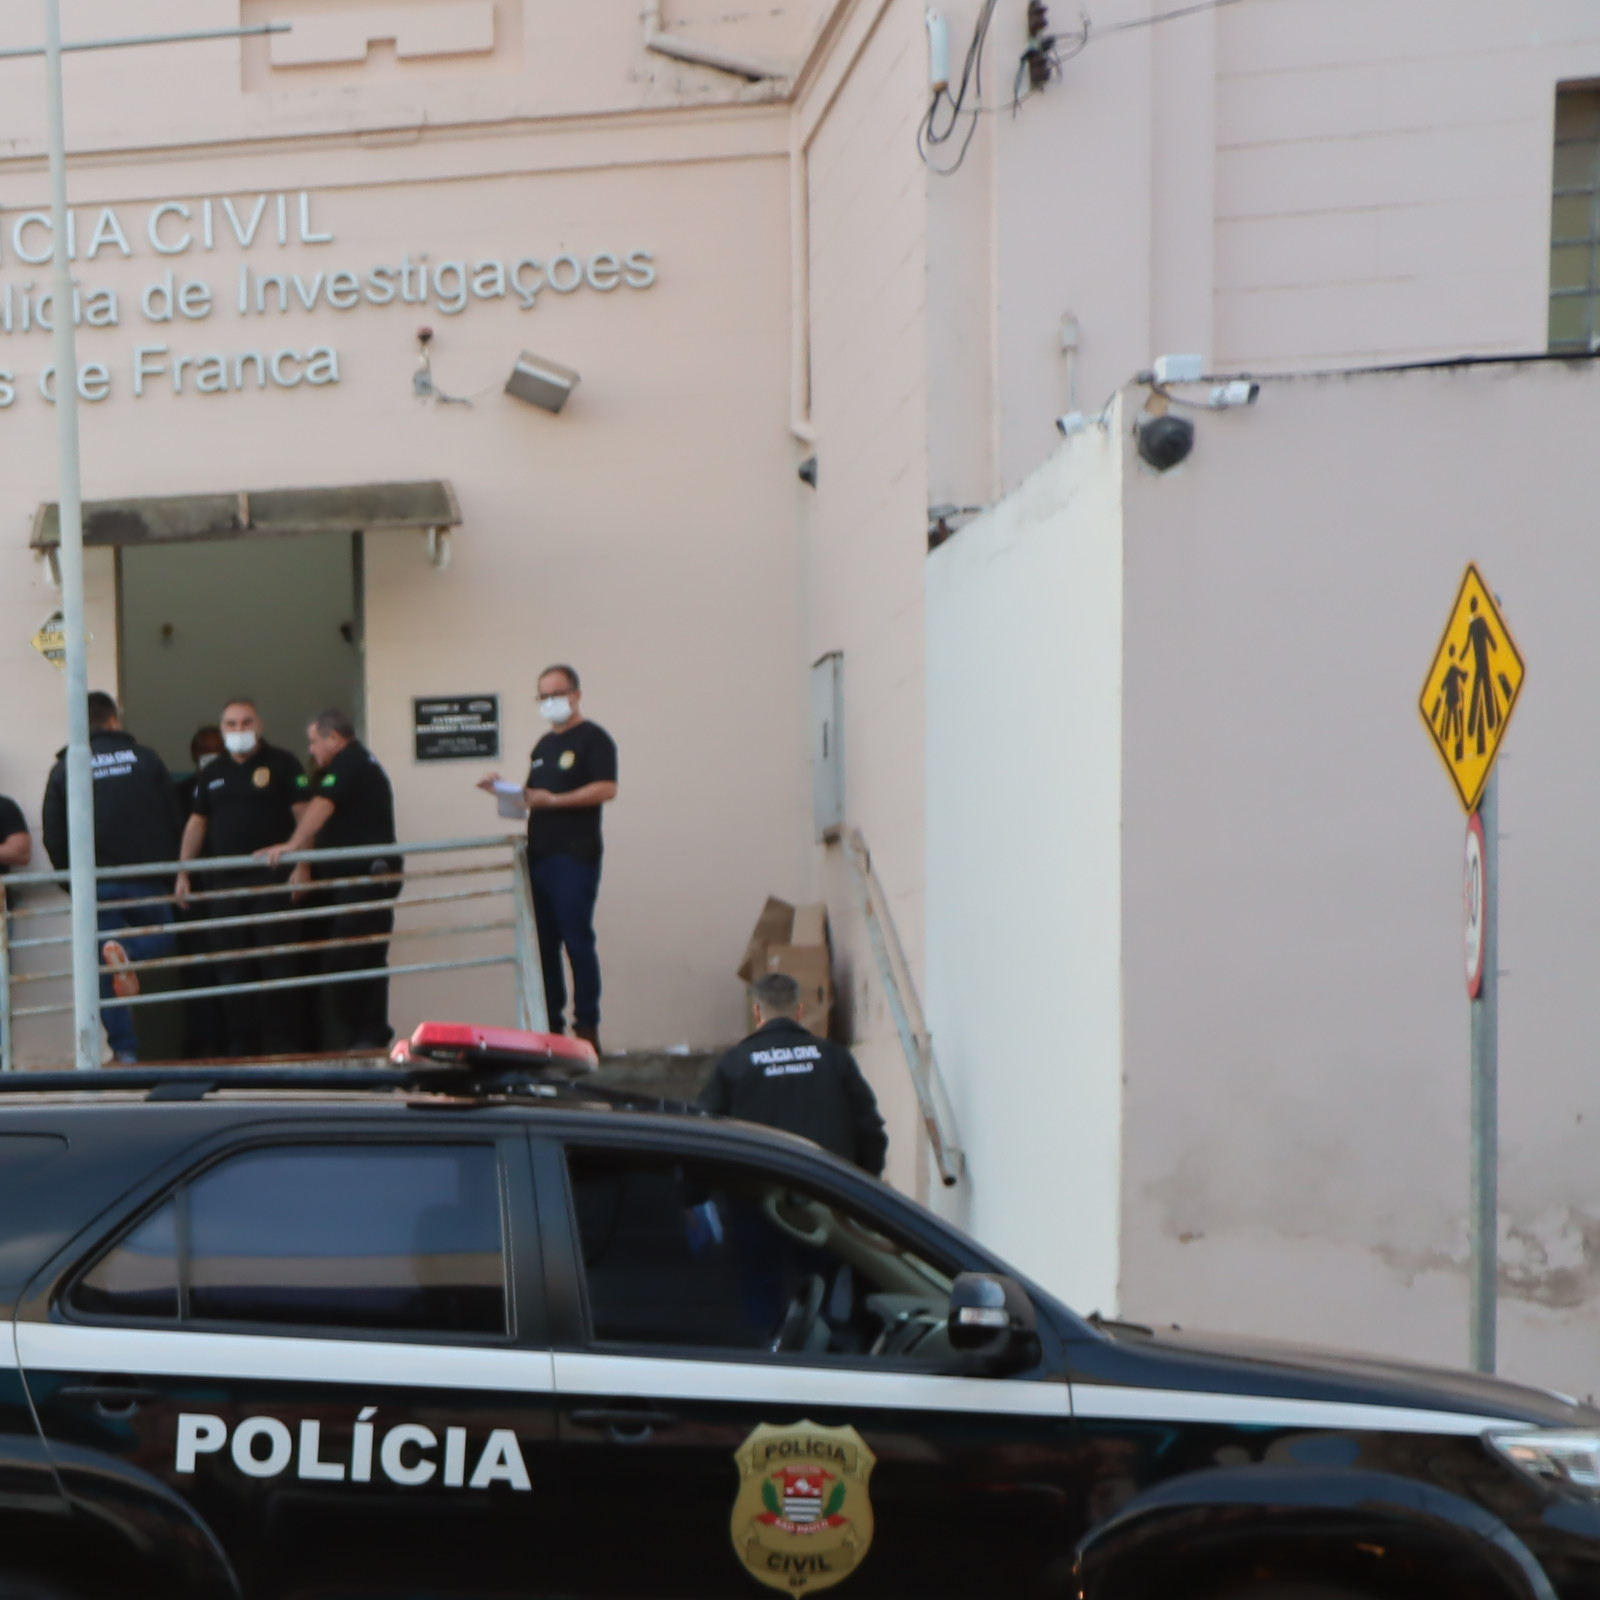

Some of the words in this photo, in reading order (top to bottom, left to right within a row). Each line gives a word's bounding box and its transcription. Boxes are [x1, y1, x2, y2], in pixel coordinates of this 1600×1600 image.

[146, 192, 334, 256] CIVIL
[142, 271, 212, 322] de
[134, 344, 341, 395] Franca
[175, 1407, 532, 1491] POLÍCIA
[765, 1437, 847, 1461] POLÍCIA
[767, 1551, 833, 1573] CIVIL
